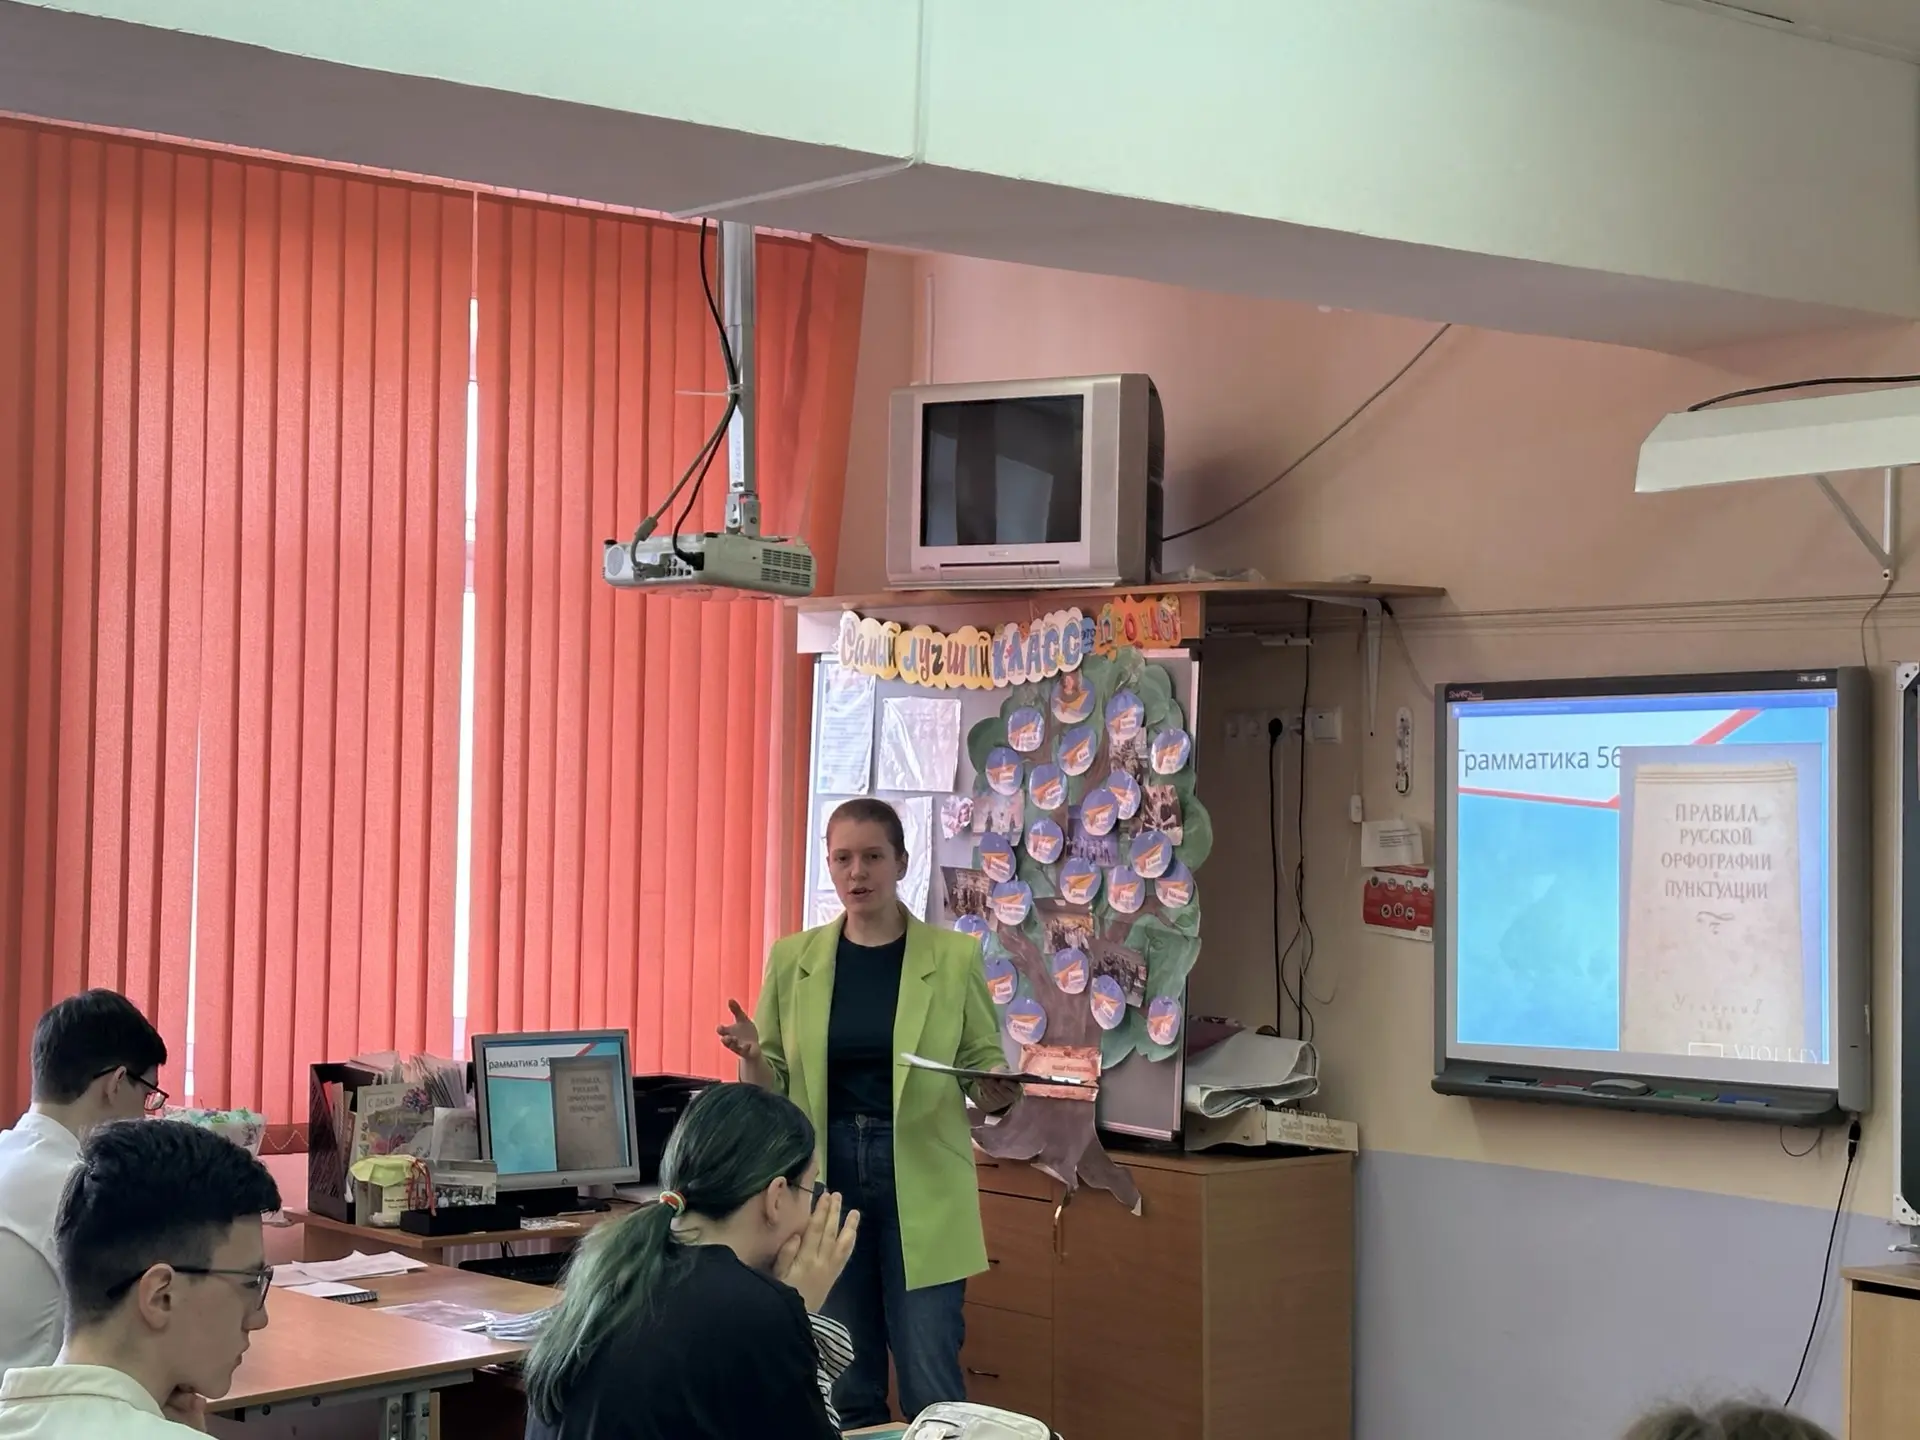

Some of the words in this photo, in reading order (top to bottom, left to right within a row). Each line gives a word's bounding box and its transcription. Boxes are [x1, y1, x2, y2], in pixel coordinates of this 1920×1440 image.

[841, 619, 897, 669] Самый
[903, 635, 991, 682] лучший
[1459, 748, 1589, 777] рамматика
[1675, 803, 1758, 822] ПРАВИЛА
[1680, 827, 1752, 845] РУССКОЙ
[1661, 852, 1771, 870] ОРФОГРАФИИ
[1665, 880, 1768, 903] ПУНКТУАЦИИ
